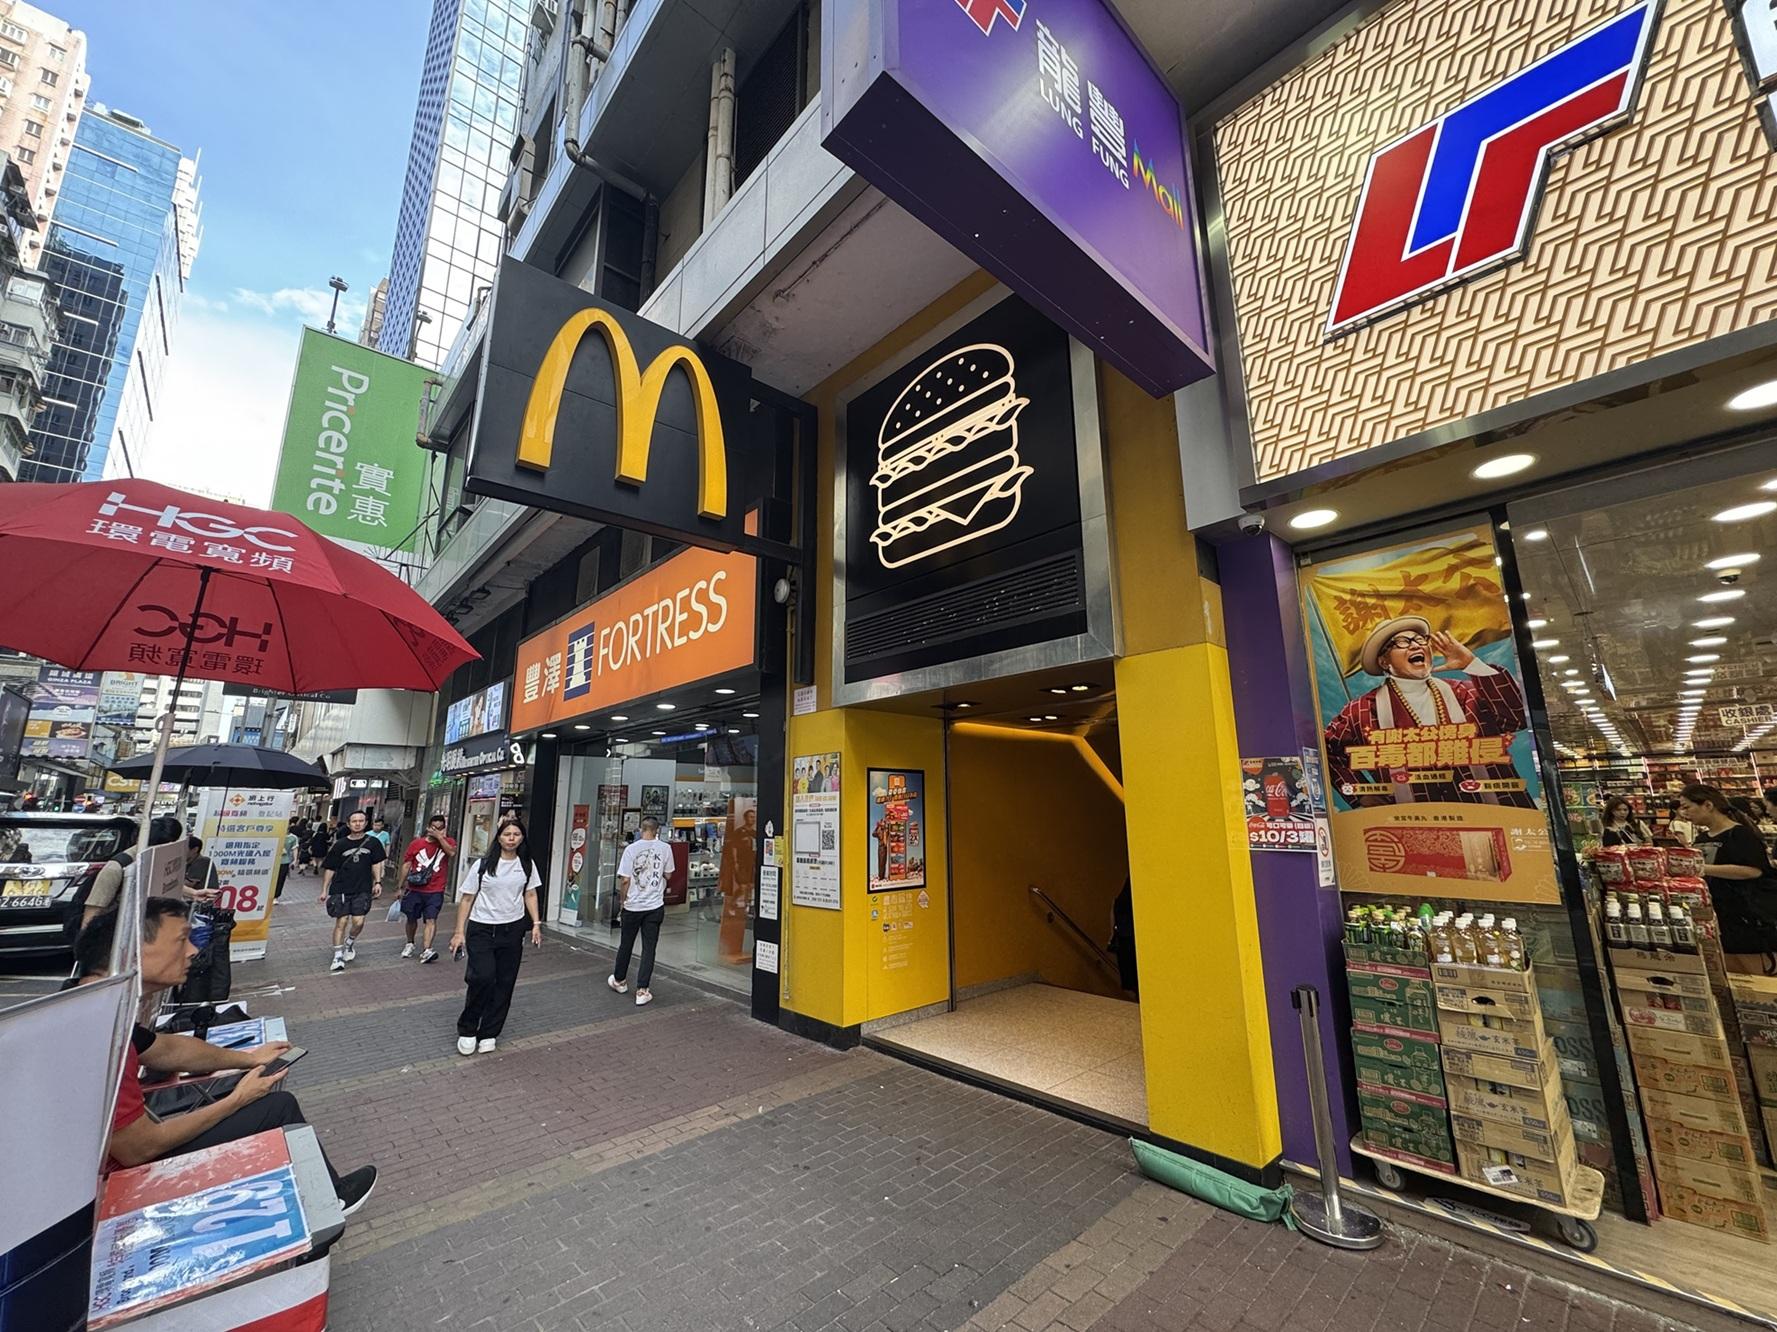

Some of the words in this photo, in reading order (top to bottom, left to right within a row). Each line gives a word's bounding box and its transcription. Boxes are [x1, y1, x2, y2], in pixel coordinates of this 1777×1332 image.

[1036, 19, 1128, 168] 龍豐
[1039, 78, 1084, 140] LUNG
[1091, 136, 1130, 190] FUNG
[1133, 138, 1184, 231] Mall
[306, 365, 369, 515] Pricerite
[98, 491, 299, 552] HGC
[347, 462, 394, 527] 實惠
[86, 518, 294, 574] 環電寬頻
[597, 570, 729, 677] FORTRESS
[523, 652, 562, 704] 豐澤
[1725, 714, 1774, 725] CASHIER
[1346, 736, 1511, 769] 百毒都難侵
[651, 853, 661, 888] KURO
